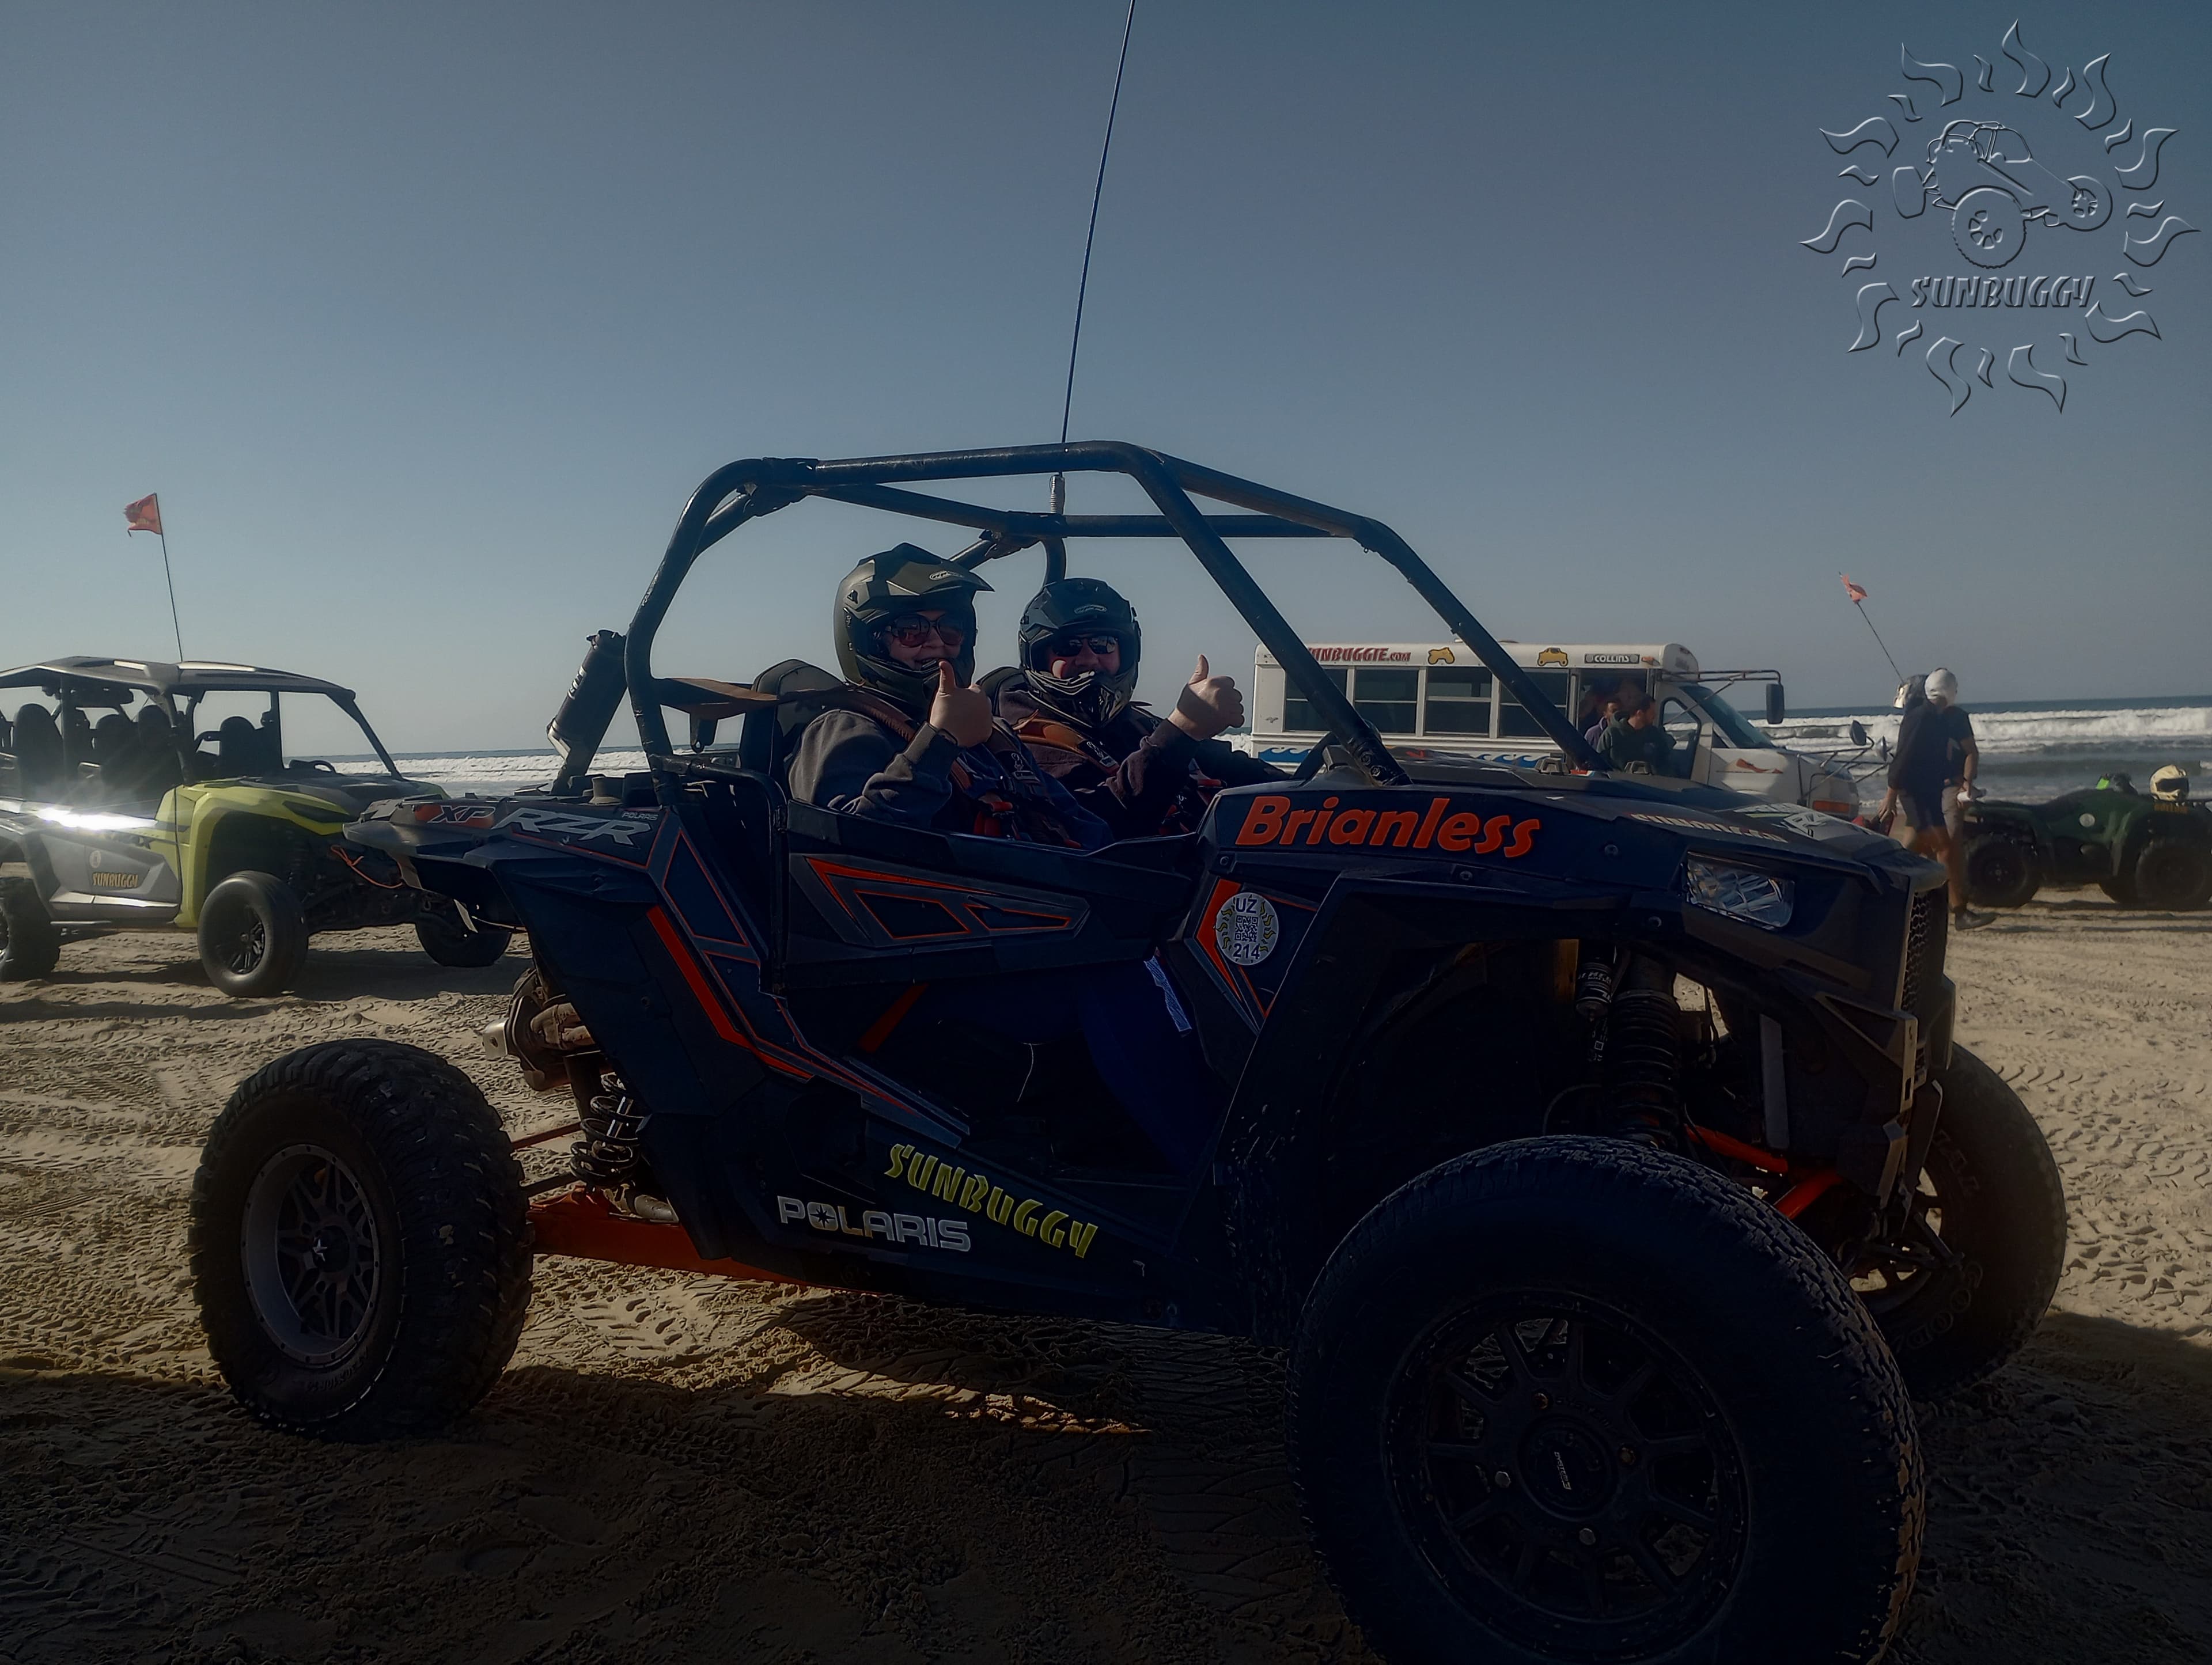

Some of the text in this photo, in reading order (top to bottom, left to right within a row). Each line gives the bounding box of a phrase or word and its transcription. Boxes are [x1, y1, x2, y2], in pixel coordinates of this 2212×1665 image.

[1593, 655, 1630, 663] COLLINS
[427, 805, 497, 824] XP
[621, 811, 659, 821] POLARIS
[490, 807, 652, 846] RZR
[1234, 795, 1541, 859] Brianless
[92, 872, 138, 888] SUNBUGGY
[1236, 898, 1257, 914] UZ
[1232, 943, 1260, 959] 214
[883, 1143, 1099, 1259] SUNBUGGY
[777, 1194, 972, 1253] POLARIS
